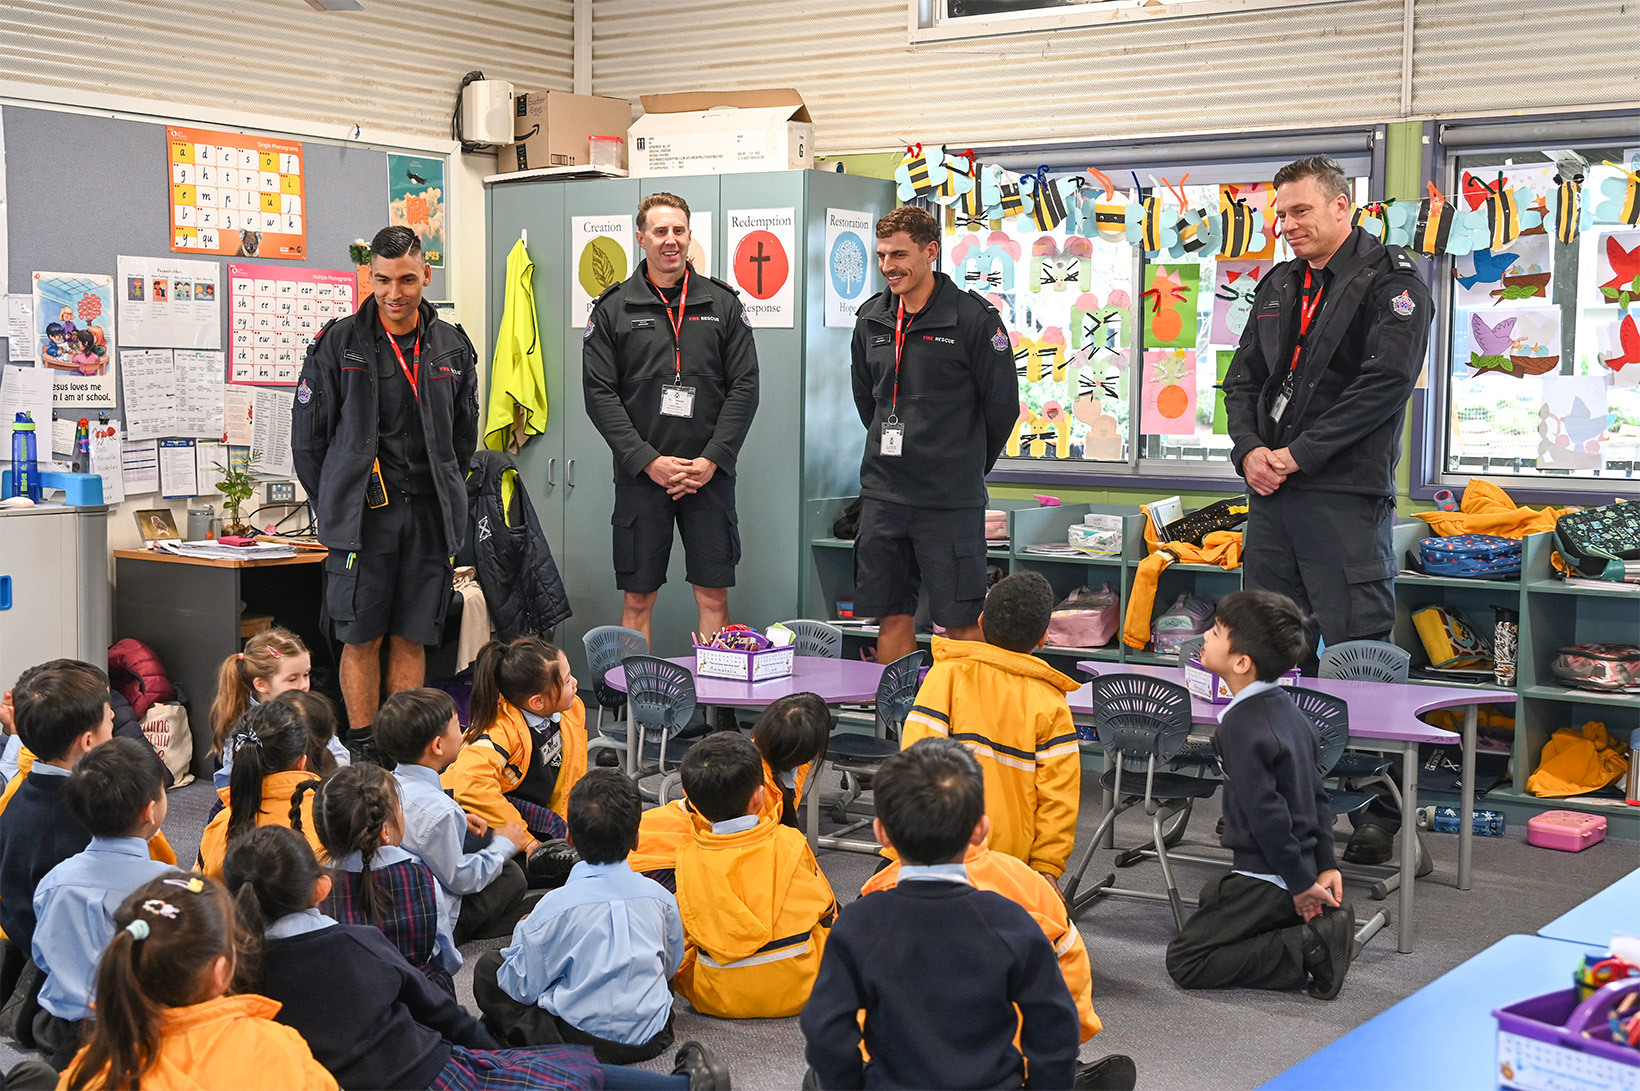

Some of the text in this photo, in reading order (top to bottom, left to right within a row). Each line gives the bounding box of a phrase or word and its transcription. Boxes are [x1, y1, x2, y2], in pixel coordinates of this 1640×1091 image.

[528, 97, 545, 105] Easter
[272, 143, 298, 152] Phonograms
[799, 143, 804, 158] G
[202, 146, 208, 159] d
[287, 155, 291, 173] f
[181, 170, 186, 183] g
[203, 167, 208, 180] h
[226, 172, 230, 181] t
[288, 178, 291, 188] i
[202, 193, 211, 201] m
[248, 192, 250, 204] l
[289, 216, 293, 228] k
[584, 221, 622, 232] Creation
[732, 215, 791, 230] Redemption
[830, 215, 869, 229] Restoration
[183, 233, 212, 248] y qu
[425, 251, 439, 260] 2025
[261, 283, 268, 292] ir
[339, 287, 346, 296] th
[238, 298, 246, 308] sh
[282, 303, 291, 314] ay
[303, 303, 310, 311] ai
[840, 302, 856, 316] Hope
[238, 320, 246, 330] oy
[261, 318, 268, 326] oi
[282, 335, 289, 343] ui
[238, 350, 246, 359] ck
[259, 367, 268, 376] kn
[279, 368, 290, 377] air
[70, 383, 88, 391] loves
